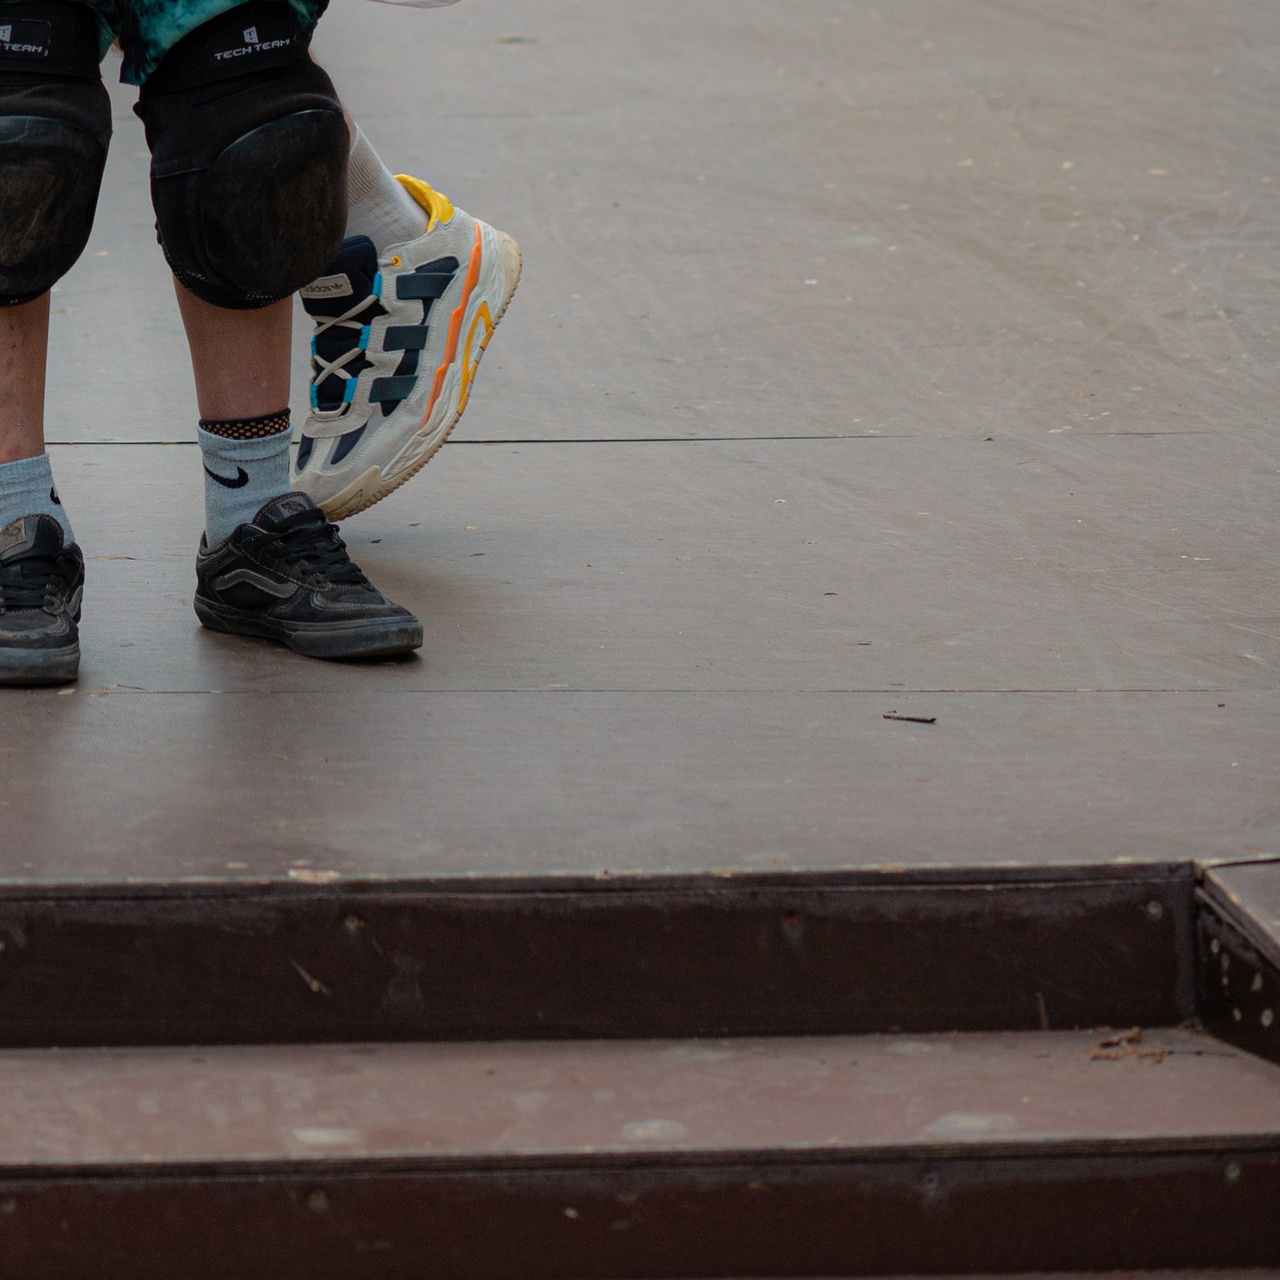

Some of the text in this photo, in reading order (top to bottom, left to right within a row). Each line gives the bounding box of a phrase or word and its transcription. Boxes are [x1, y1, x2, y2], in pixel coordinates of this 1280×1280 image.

[3, 43, 43, 53] TEAM
[213, 38, 291, 61] TECH TEAM
